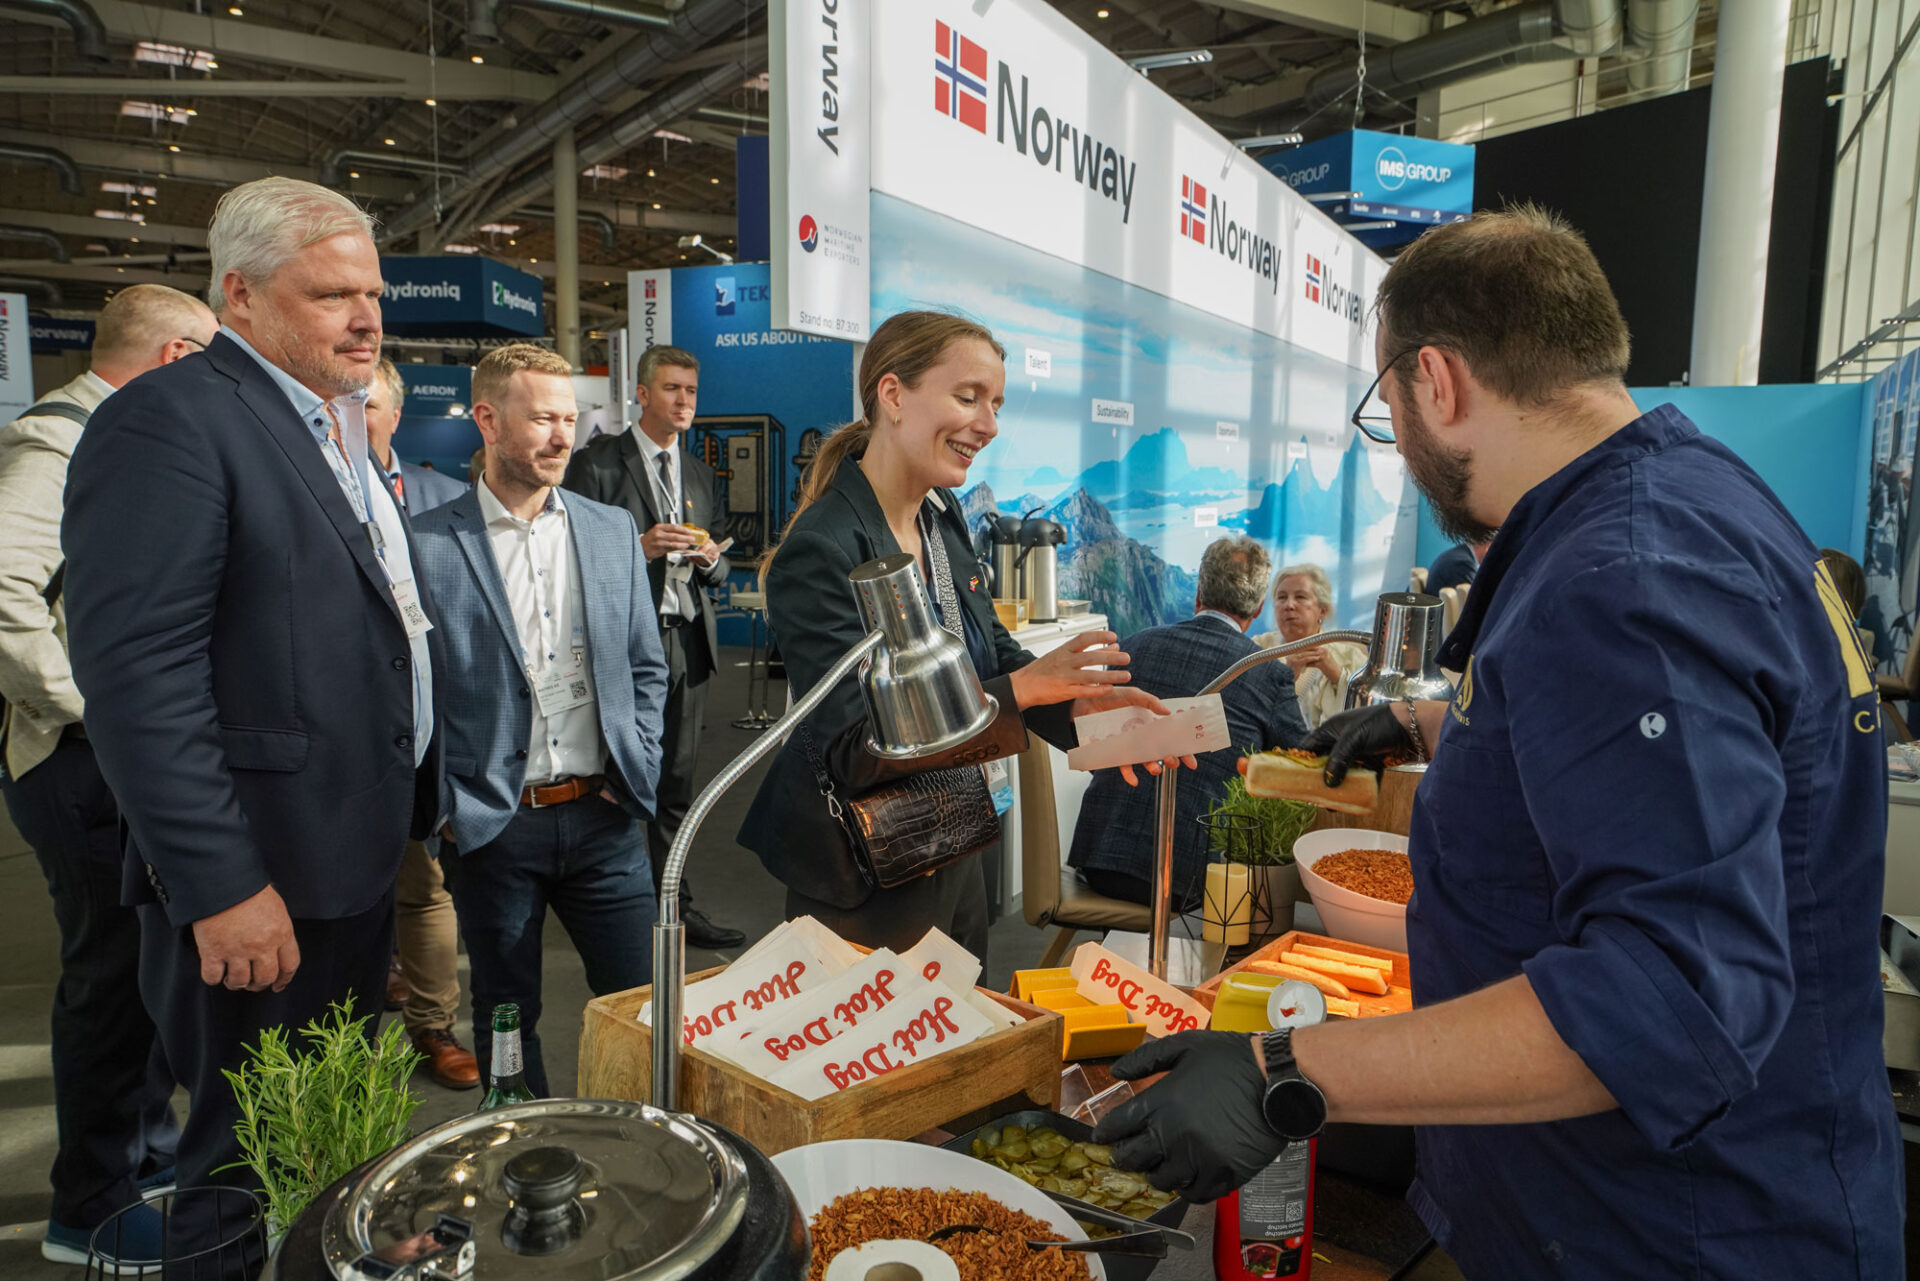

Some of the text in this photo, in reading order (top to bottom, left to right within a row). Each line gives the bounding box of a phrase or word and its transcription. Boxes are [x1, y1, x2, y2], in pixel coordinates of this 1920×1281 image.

[997, 60, 1136, 224] Norway
[1380, 160, 1451, 184] IMS GROUP
[1210, 193, 1282, 296] Norway
[503, 289, 537, 317] Hydroniq
[800, 311, 822, 327] Stand
[1321, 264, 1365, 334] Norway
[715, 333, 739, 347] ASK
[742, 332, 758, 345] US
[412, 384, 456, 396] AERON
[1097, 404, 1130, 422] Sustainability
[742, 960, 807, 1011] Hot
[833, 969, 896, 1028] Hot
[1090, 958, 1198, 1033] Hot Dog
[763, 1016, 845, 1061] Dog
[823, 996, 960, 1091] Hot Dog
